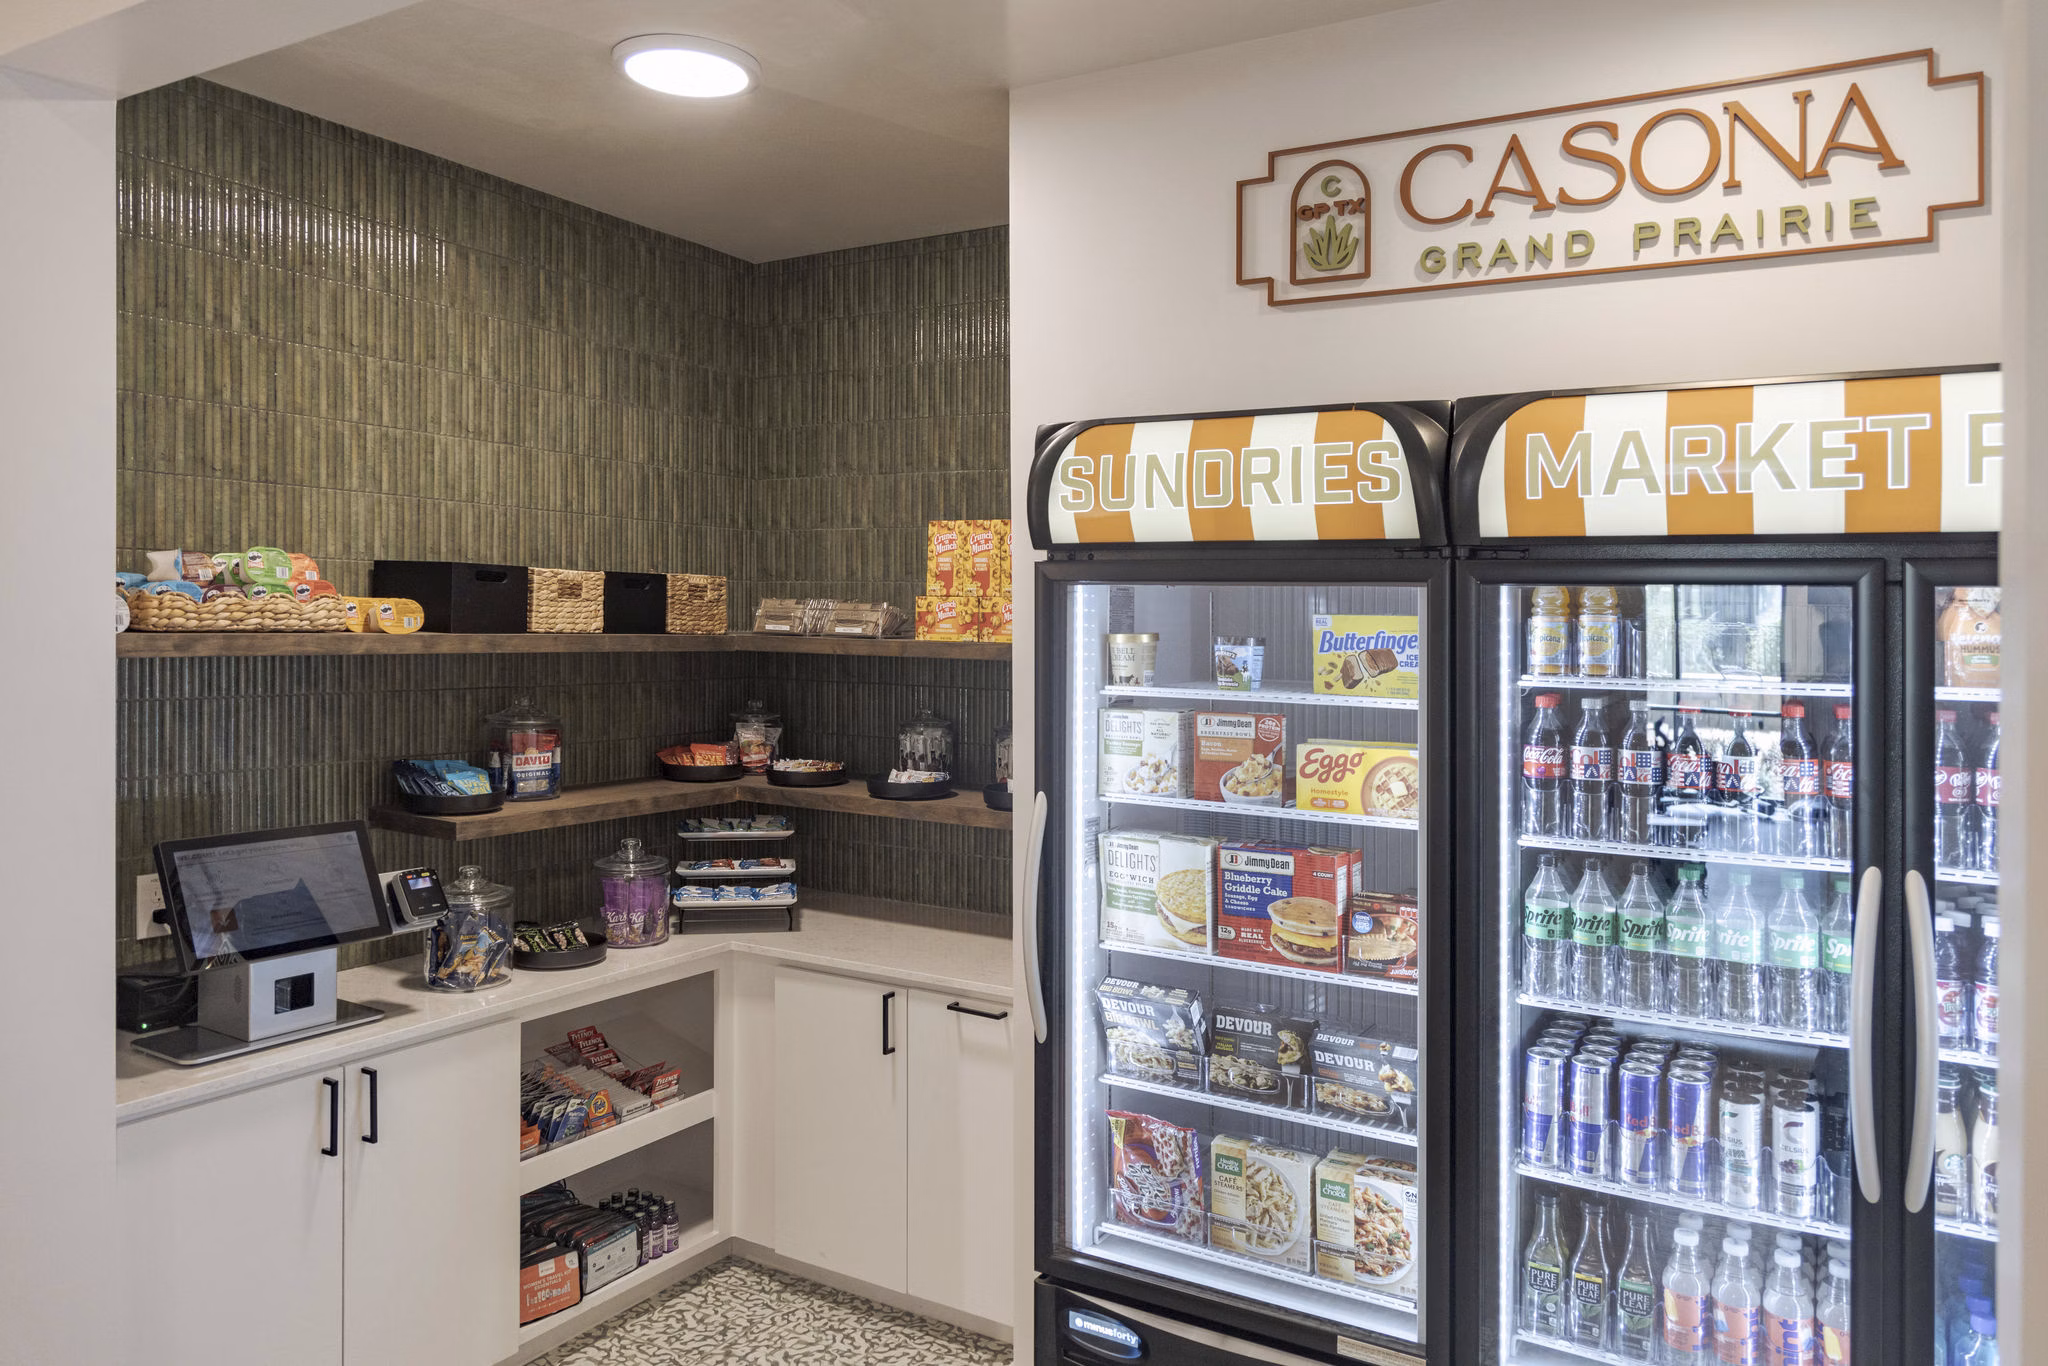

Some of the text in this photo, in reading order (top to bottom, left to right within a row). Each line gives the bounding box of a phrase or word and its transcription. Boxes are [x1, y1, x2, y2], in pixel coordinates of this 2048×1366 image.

[1400, 82, 1905, 225] CASONA
[1320, 175, 1342, 197] C
[1297, 197, 1365, 222] GP TX
[1420, 198, 1879, 275] GRAND PRAIRIE
[1525, 412, 1931, 500] MARKET
[1059, 440, 1402, 513] SUNDRIES
[934, 531, 957, 544] Crunch
[970, 530, 992, 544] Crunch
[936, 541, 957, 556] Munch
[972, 541, 992, 556] Munch
[1319, 630, 1418, 654] Butterfinge
[1540, 635, 1560, 643] picana
[1400, 660, 1418, 668] CREA
[1105, 720, 1142, 734] DELIGHTS
[515, 754, 551, 767] DAVID
[1524, 746, 1564, 764] Coca-Cola
[1299, 748, 1365, 783] Eggo
[516, 770, 550, 778] ORIGINAL
[1310, 788, 1348, 796] Homestyle
[1108, 850, 1156, 872] DELIGHTS
[1224, 872, 1272, 886] Blueberry
[1224, 882, 1288, 897] Griddle Cake
[1524, 905, 1562, 926] Sprite
[1571, 912, 1610, 931] Sprite
[1220, 927, 1232, 935] 12g
[1240, 932, 1264, 940] REAL
[1667, 923, 1710, 944] Sprite
[1718, 930, 1750, 947] rite
[1770, 932, 1816, 952] Sprite
[1826, 938, 1852, 958] Spr
[1104, 977, 1140, 989] DEVOUR
[1112, 987, 1134, 996] BOWL
[1100, 997, 1156, 1017] DEVOUR
[1216, 1014, 1272, 1036] DEVOUR
[571, 1030, 594, 1041] TYLENOL
[1316, 1034, 1355, 1046] DEVOUR
[578, 1036, 602, 1049] TYLENOL
[590, 1052, 614, 1064] TYLENOL
[1314, 1050, 1375, 1072] DEVOUR
[656, 1074, 678, 1086] TYLENOL
[1626, 1113, 1647, 1128] Red
[1781, 1144, 1808, 1154] CELSIUS
[1217, 1162, 1240, 1172] Choice
[1220, 1157, 1239, 1167] Healthy
[1219, 1174, 1237, 1184] CAFÉ
[1214, 1180, 1244, 1192] STEAMERS
[1325, 1183, 1346, 1193] Healthy
[1322, 1188, 1346, 1198] Choice
[1531, 1269, 1558, 1280] PURE
[1531, 1277, 1556, 1288] LEAF
[1578, 1280, 1600, 1291] PURE
[1578, 1288, 1600, 1298] LEAF
[1622, 1291, 1650, 1302] PURE
[1622, 1298, 1650, 1311] LEAF
[1083, 1320, 1136, 1344] minusforty
